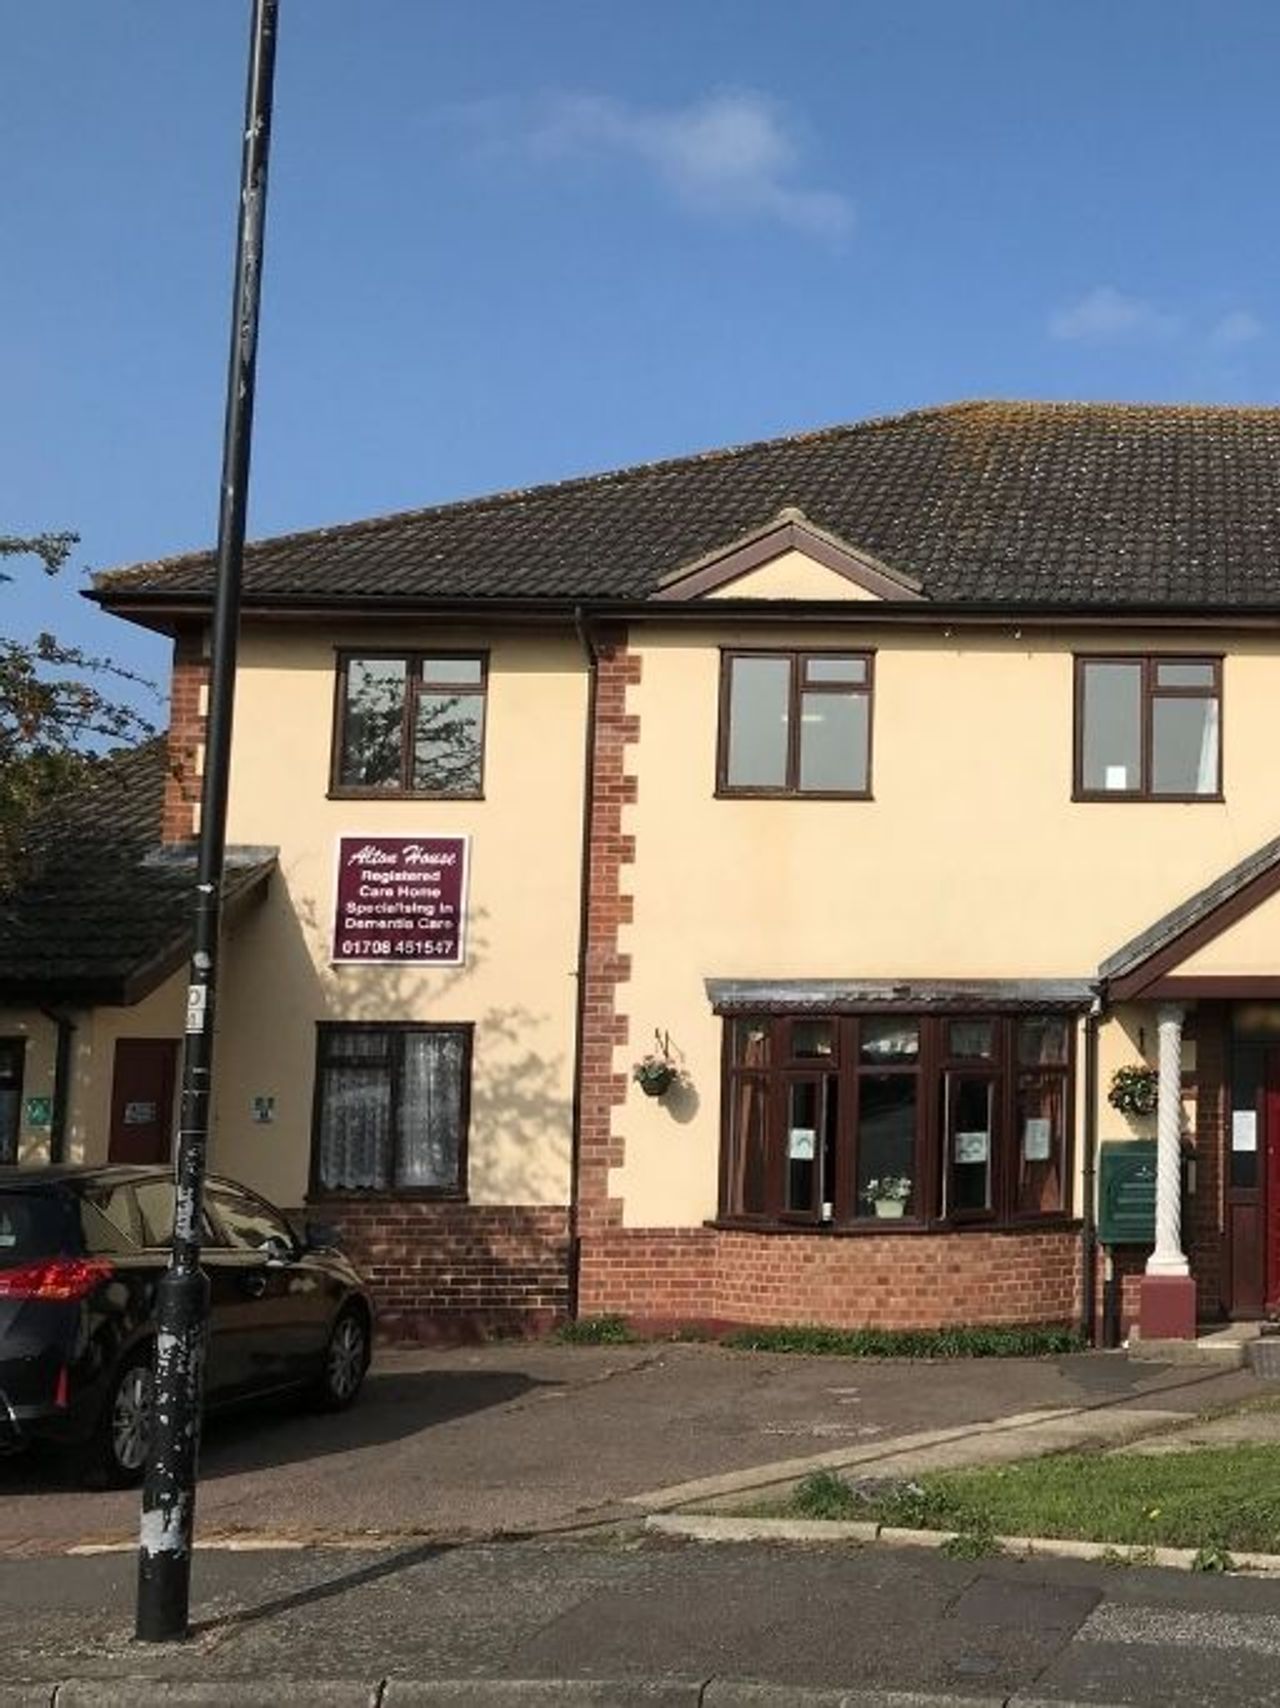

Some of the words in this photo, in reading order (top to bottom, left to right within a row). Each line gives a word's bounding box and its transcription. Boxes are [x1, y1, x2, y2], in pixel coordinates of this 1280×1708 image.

[348, 845, 397, 866] Alton
[402, 845, 456, 866] House
[362, 870, 441, 883] Registered
[359, 885, 394, 898] Care
[398, 886, 441, 898] Home
[346, 902, 435, 915] Specialising
[345, 918, 413, 929] Dementia
[418, 918, 453, 929] Care
[342, 940, 391, 954] 01708
